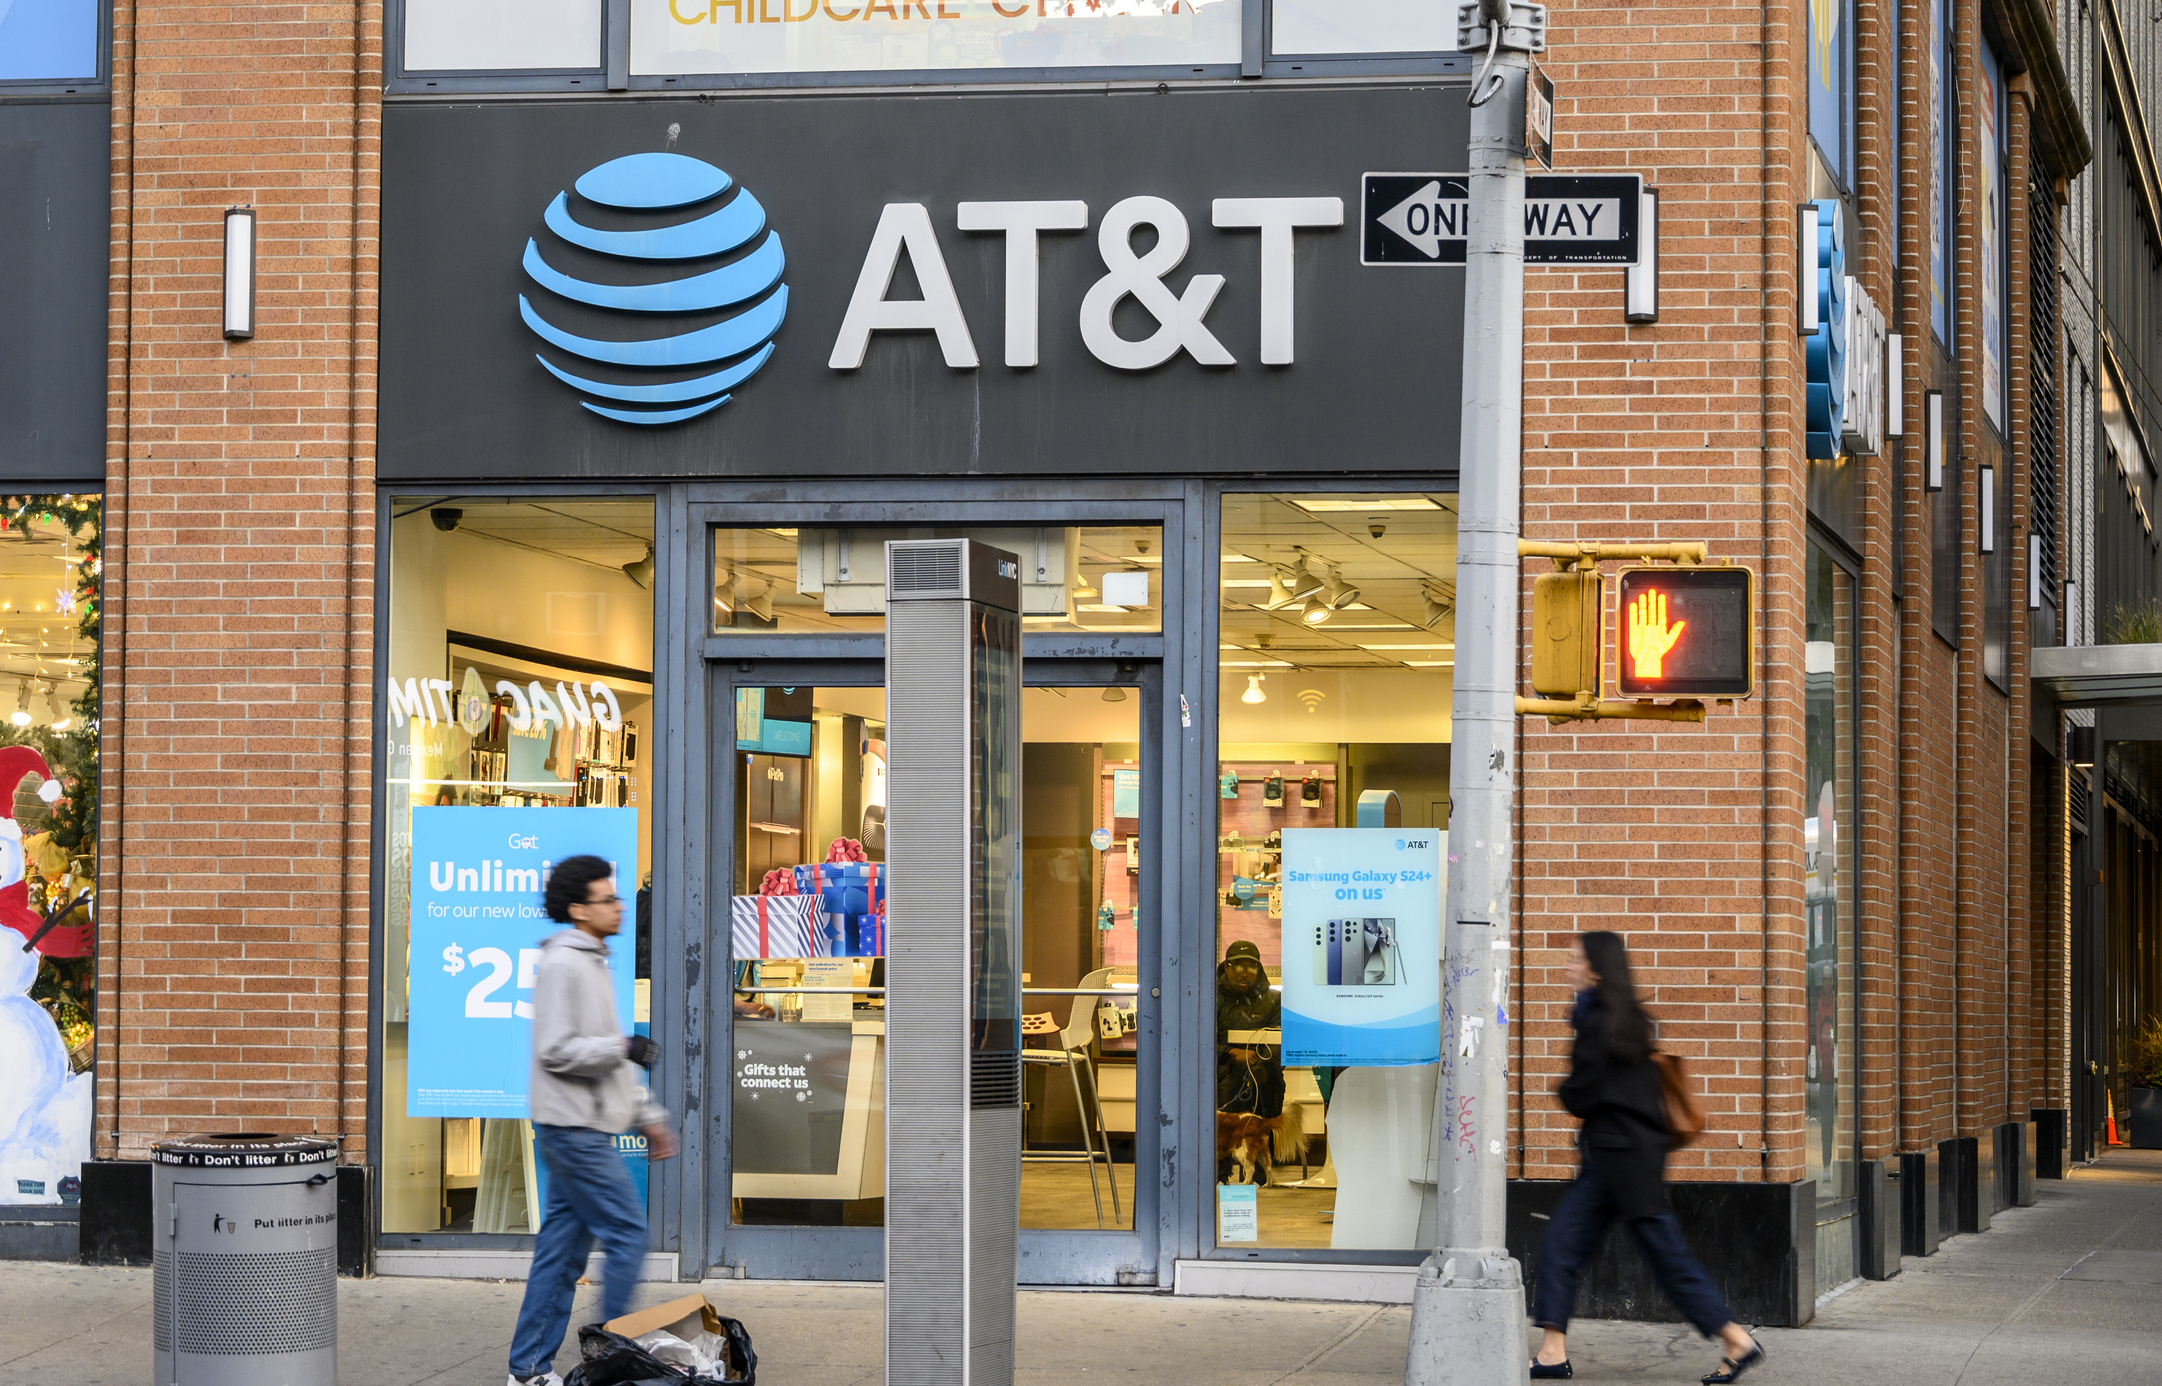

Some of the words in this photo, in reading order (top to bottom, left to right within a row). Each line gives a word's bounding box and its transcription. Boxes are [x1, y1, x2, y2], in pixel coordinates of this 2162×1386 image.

[827, 195, 1344, 369] AT&T
[773, 729, 801, 743] WELCOME
[508, 833, 539, 849] Get
[1407, 841, 1429, 849] AT&T
[1289, 870, 1349, 884] Samsung
[1352, 870, 1398, 884] Galaxy
[1400, 870, 1433, 882] S24+
[1334, 888, 1358, 900] on
[427, 901, 450, 918] for
[453, 905, 479, 918] our
[482, 905, 515, 918] new
[744, 1063, 776, 1076] Gifts
[778, 1063, 806, 1076] that
[740, 1077, 791, 1088] connect
[793, 1078, 809, 1089] us
[162, 1152, 184, 1163] litter
[204, 1154, 240, 1166] Don't
[245, 1154, 277, 1165] litter
[300, 1150, 325, 1163] Don't
[254, 1218, 274, 1229] Put
[305, 1215, 313, 1226] in
[315, 1214, 325, 1224] its
